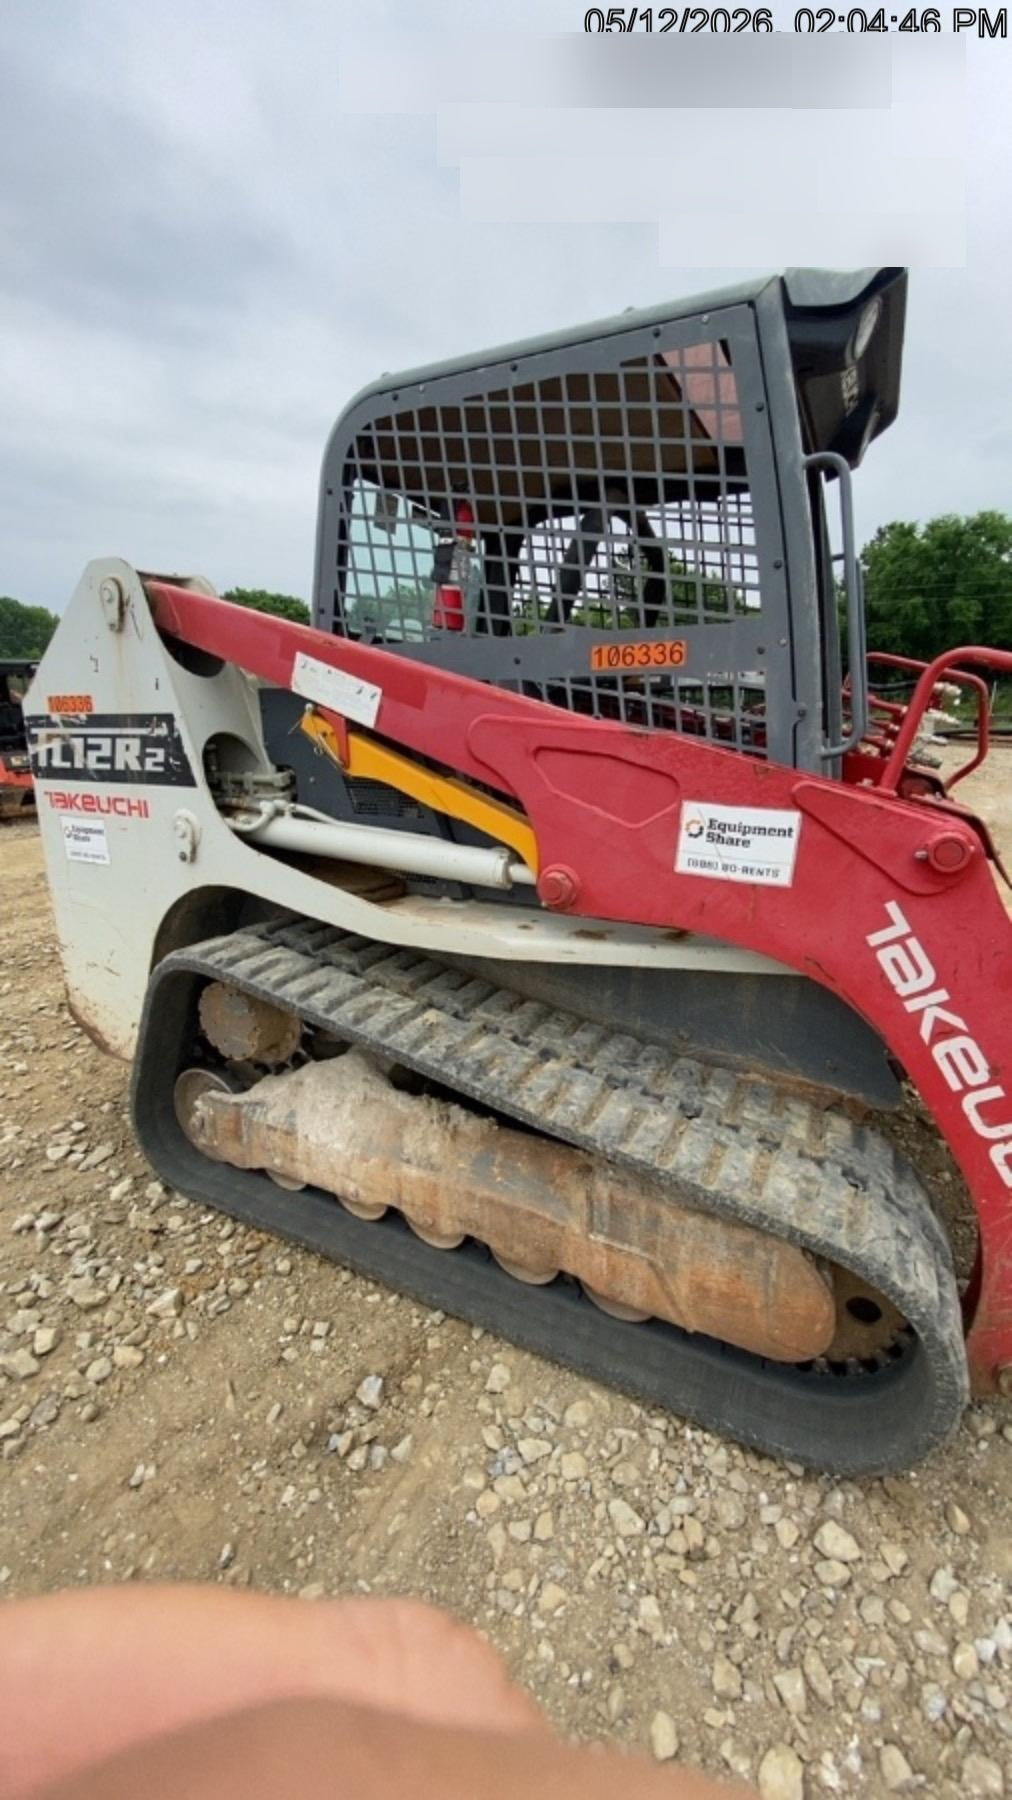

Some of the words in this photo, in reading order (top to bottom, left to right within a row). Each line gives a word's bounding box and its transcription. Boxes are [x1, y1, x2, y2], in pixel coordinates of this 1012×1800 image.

[594, 641, 683, 668] 106336
[707, 818, 794, 838] Equipment
[706, 832, 751, 848] Share
